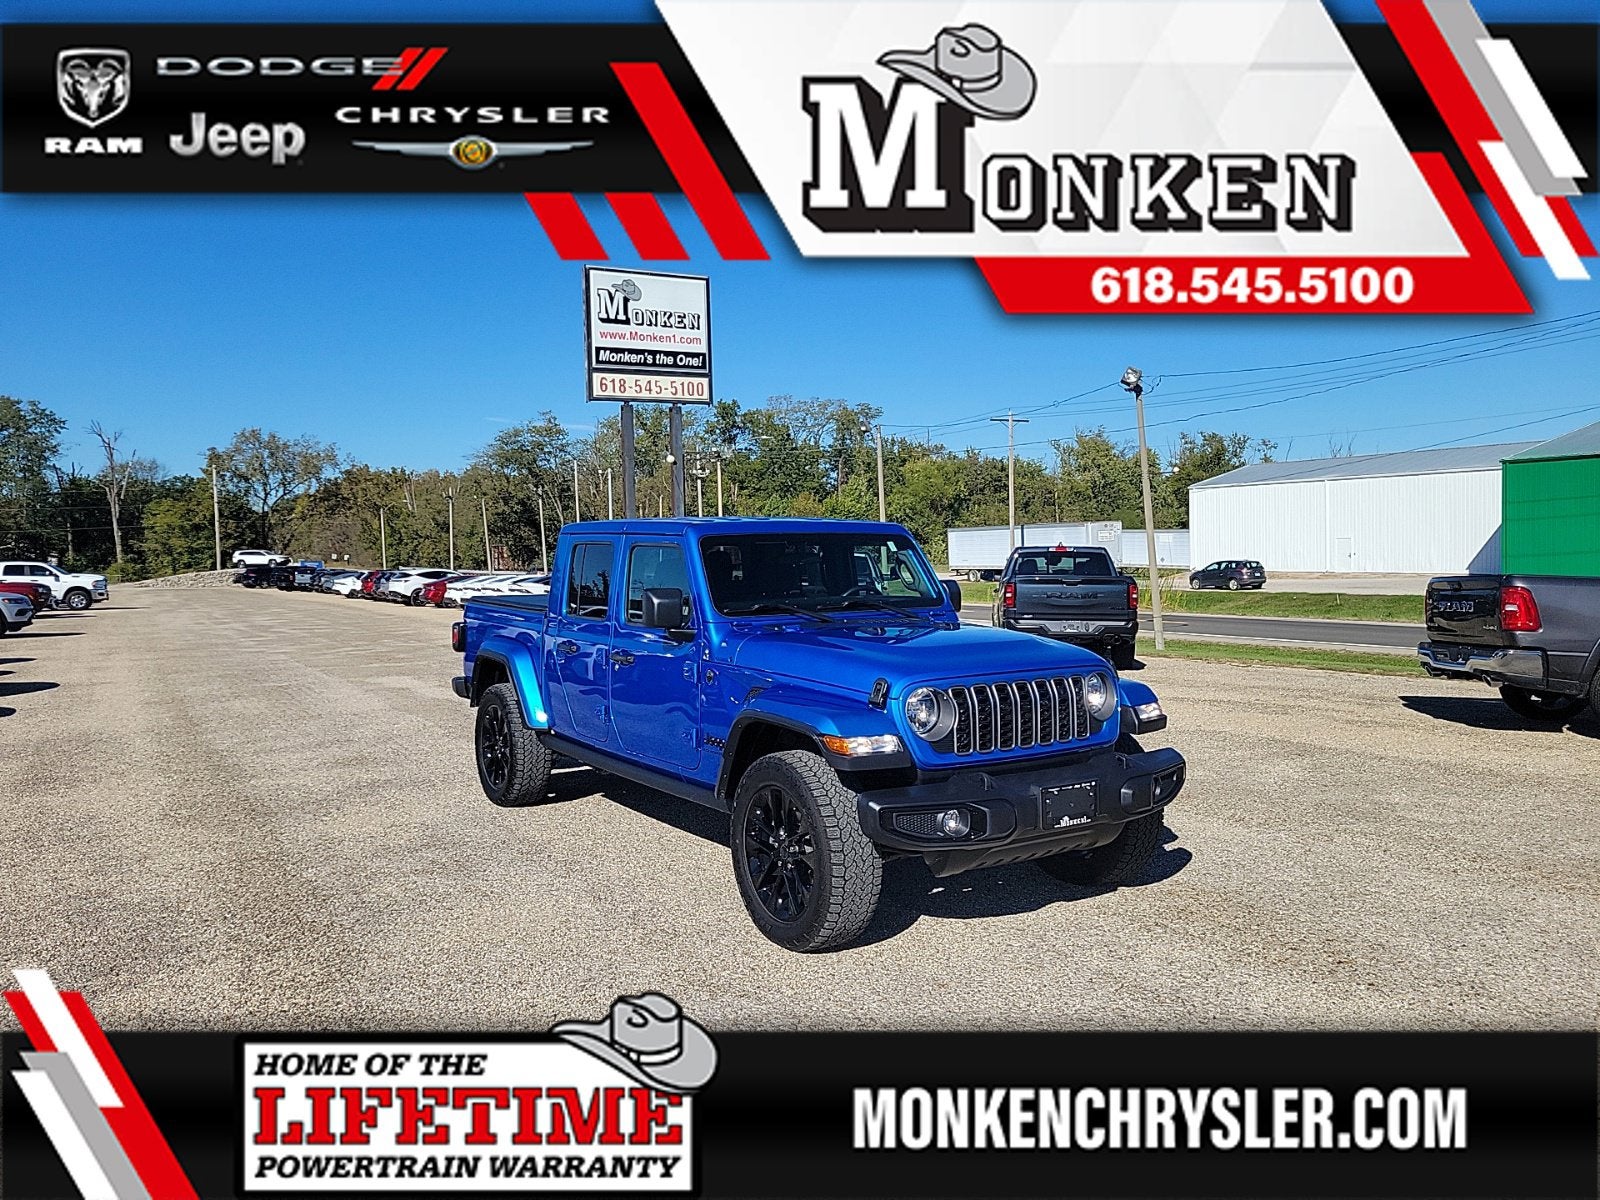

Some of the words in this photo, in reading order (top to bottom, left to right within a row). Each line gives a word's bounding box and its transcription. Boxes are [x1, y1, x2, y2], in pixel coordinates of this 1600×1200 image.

[599, 331, 702, 345] www.Monken1.com
[598, 349, 654, 364] Monken's
[655, 353, 674, 365] the
[676, 355, 703, 367] One!
[599, 376, 705, 397] 618-545-5100
